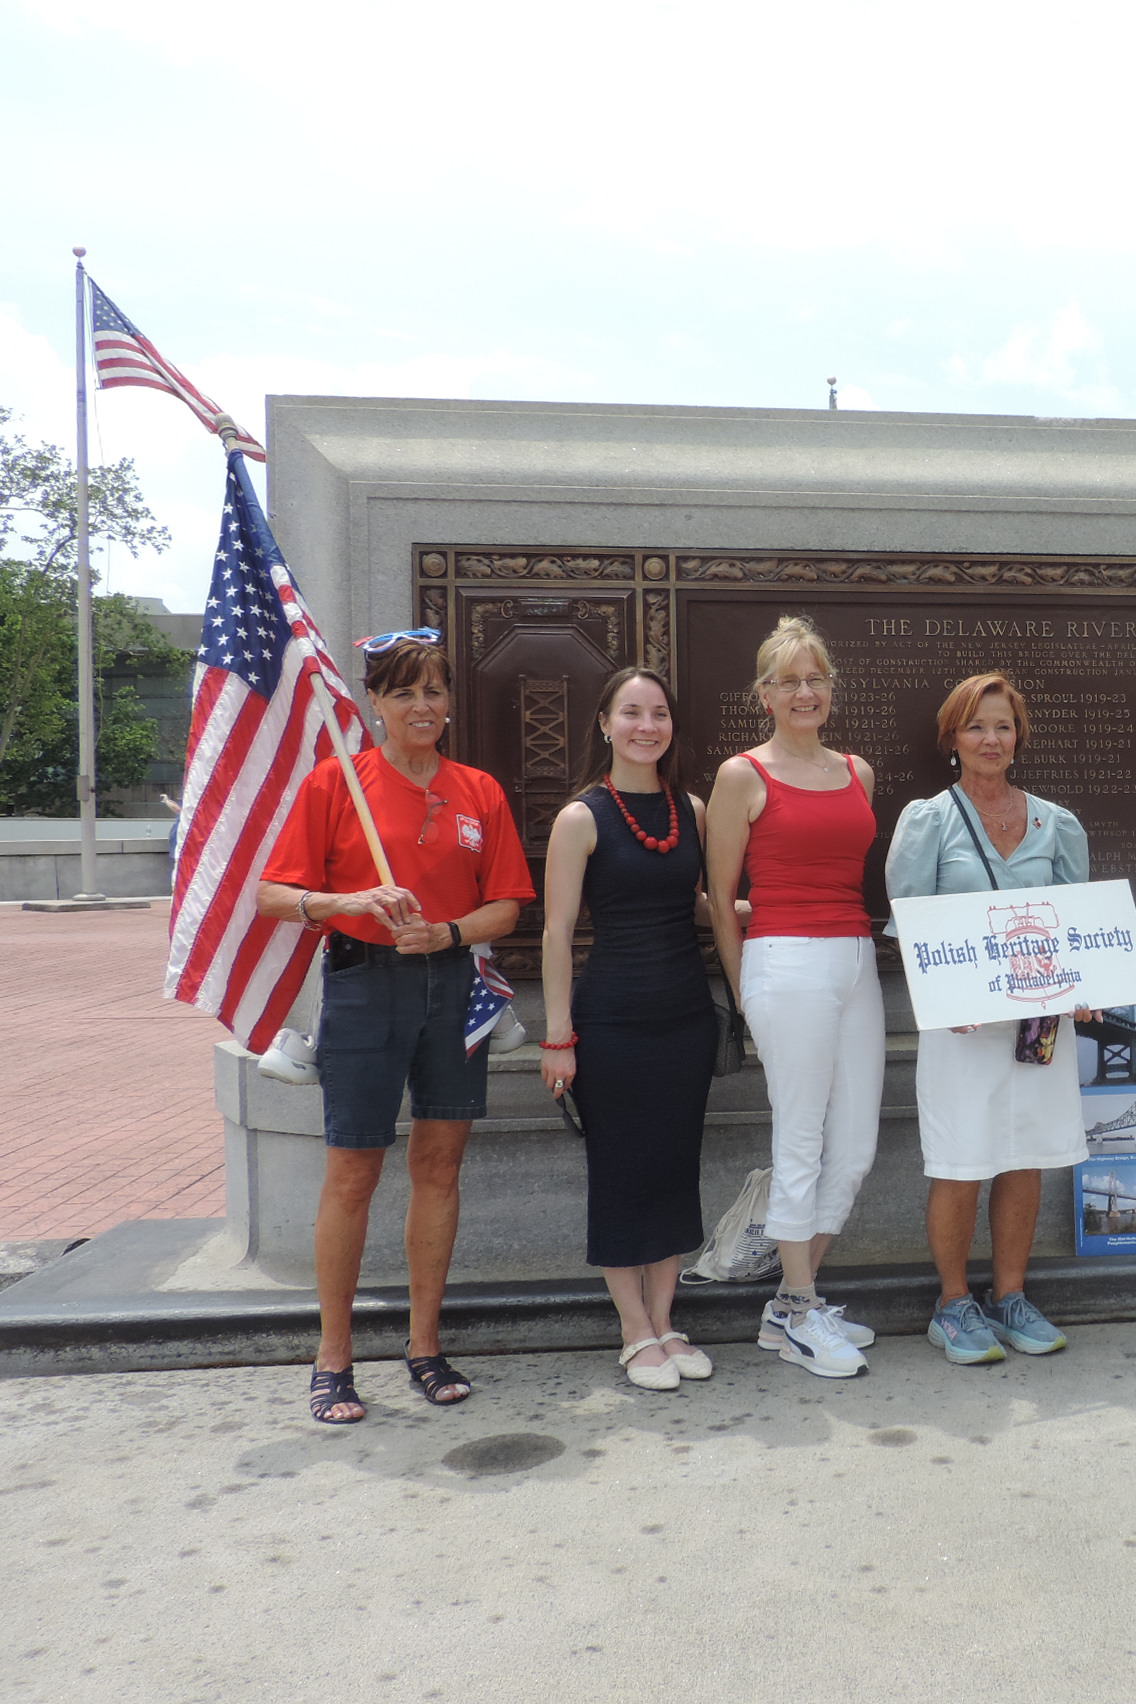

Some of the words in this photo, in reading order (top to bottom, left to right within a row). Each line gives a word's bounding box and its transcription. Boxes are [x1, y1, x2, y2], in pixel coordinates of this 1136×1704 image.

[865, 618, 914, 636] THE
[925, 619, 1055, 638] DELAWARE
[937, 650, 950, 658] TO
[1019, 651, 1055, 659] BRIDGE
[1059, 651, 1088, 659] OVER
[1093, 651, 1111, 659] THE
[860, 658, 872, 666] OF
[877, 658, 949, 667] CONSTRUCTION
[956, 659, 994, 667] SHARED
[1001, 659, 1012, 667] BY
[1017, 659, 1035, 667] THE
[1040, 659, 1124, 668] COMMONWEALTH
[1034, 668, 1108, 677] CONSTRUCTION
[843, 692, 897, 702] 1923-26
[1079, 694, 1128, 704] 1919-23
[843, 705, 897, 716] 1919-26
[1027, 708, 1079, 718] SNYDER
[1083, 708, 1132, 718] 1919-25
[845, 718, 898, 729] 1921-26
[1028, 724, 1076, 734] MOORE
[1082, 724, 1135, 734] 1919-24
[847, 732, 901, 742] 1921-26
[1024, 739, 1079, 750] KEPHART
[1085, 739, 1132, 750] 1919-21
[859, 746, 911, 756] 1921-26
[1072, 754, 1121, 764] 1919-21
[1083, 770, 1133, 780] 1921-22
[913, 938, 979, 975] Polish
[982, 934, 1060, 966] Heritage
[1067, 926, 1134, 952] Society
[988, 975, 1003, 993] of
[1004, 967, 1083, 993] Philadelphia
